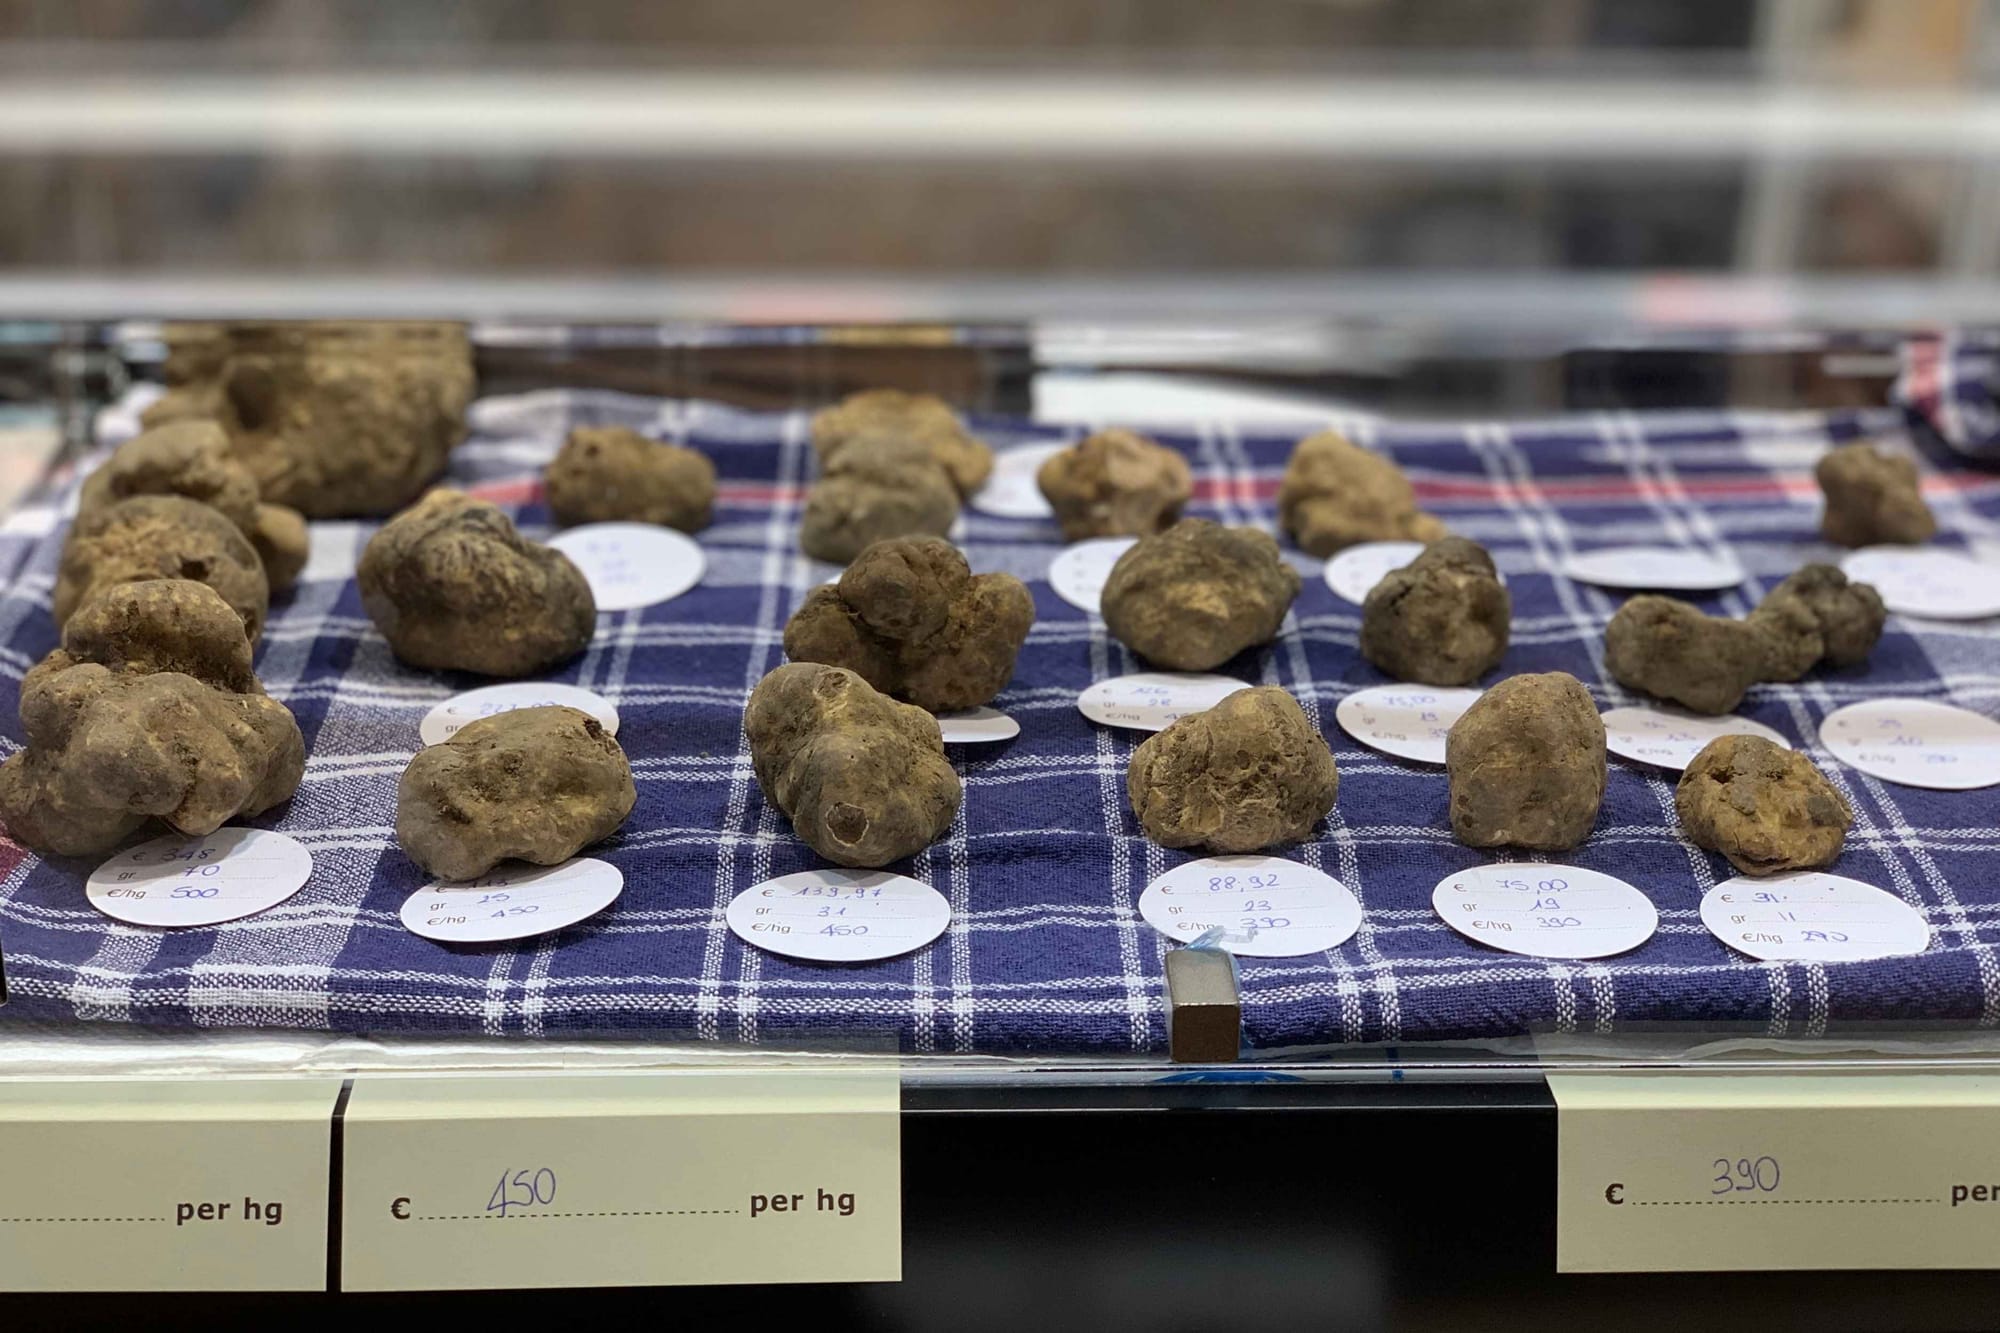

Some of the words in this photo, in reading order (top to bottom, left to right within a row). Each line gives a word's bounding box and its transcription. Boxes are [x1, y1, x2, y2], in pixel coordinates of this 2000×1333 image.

[117, 871, 137, 881] gr
[183, 864, 221, 877] 70
[107, 888, 147, 900] €/hg
[170, 886, 220, 899] 500
[762, 889, 774, 898] €
[1161, 885, 1175, 895] €
[1453, 883, 1467, 893] €
[1720, 894, 1735, 903] €
[430, 902, 447, 912] gr
[1168, 906, 1184, 915] gr
[1462, 902, 1478, 913] gr
[1529, 897, 1561, 912] 19
[755, 906, 772, 917] gr
[817, 906, 847, 918] 31
[426, 916, 467, 926] €/hg
[1471, 920, 1513, 932] €/hg
[1536, 916, 1582, 928] 390
[1730, 915, 1747, 925] gr
[751, 921, 791, 935] €/hg
[819, 923, 869, 937] 450
[1741, 932, 1784, 945] €/hg
[1605, 1183, 1625, 1205] €
[1712, 1156, 1781, 1195] 390
[1951, 1183, 2000, 1207] per
[390, 1196, 412, 1221] €
[486, 1167, 557, 1219] 450
[750, 1193, 805, 1218] per
[817, 1187, 856, 1217] hg
[176, 1202, 231, 1226] per
[244, 1196, 283, 1226] hg
